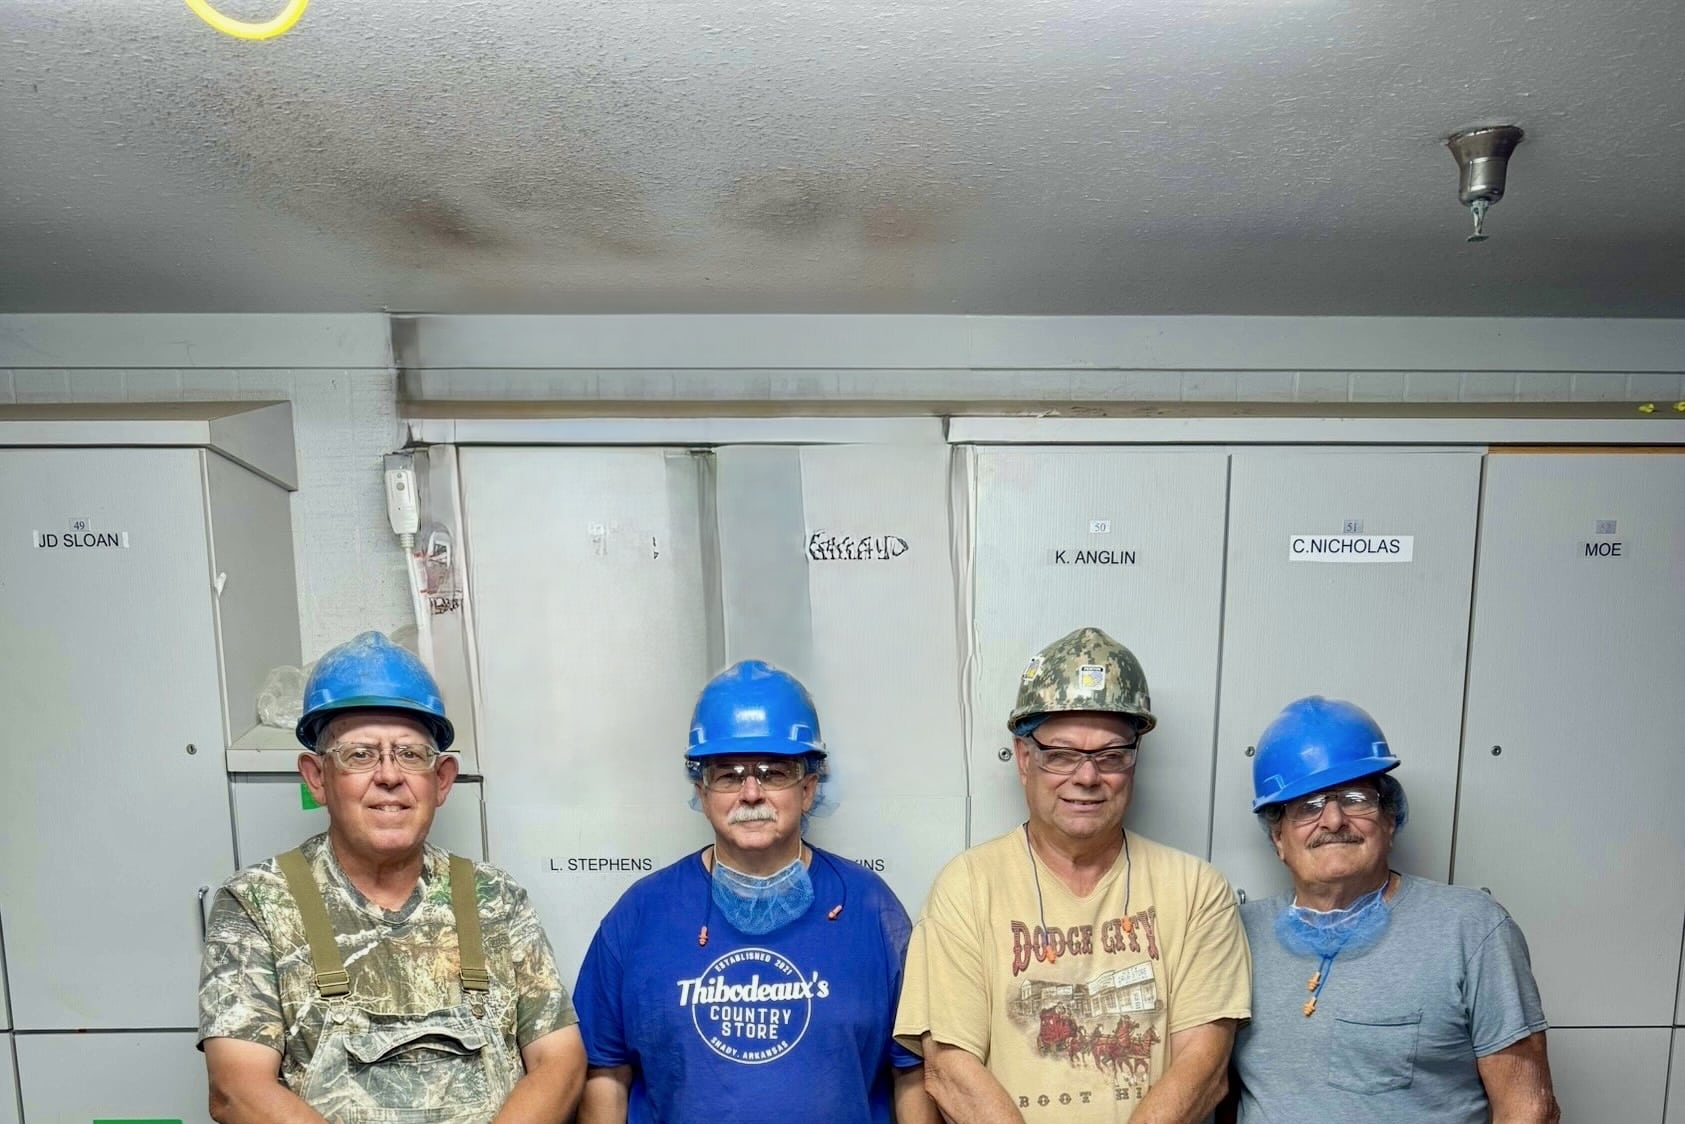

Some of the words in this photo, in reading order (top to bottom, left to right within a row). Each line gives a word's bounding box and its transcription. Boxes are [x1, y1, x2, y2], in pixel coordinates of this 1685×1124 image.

[73, 520, 85, 531] 49
[1094, 522, 1106, 532] 50
[38, 533, 58, 548] JD
[63, 533, 119, 548] SLOAN
[1292, 538, 1400, 554] C.NICHOLAS
[1585, 542, 1622, 556] MOE
[1055, 550, 1070, 565] K.
[1074, 550, 1136, 565] ANGLIN
[550, 858, 563, 871] L.
[567, 858, 653, 871] STEPHENS
[1011, 919, 1093, 977] DODGE
[1101, 905, 1160, 961] CITY
[714, 952, 771, 973] ESTABLISHED
[676, 970, 830, 1007] Thibodeaux's
[710, 1006, 792, 1025] COUNTRY
[721, 1021, 779, 1040] STORE
[742, 1040, 789, 1060] ARKANSAS
[1018, 1090, 1092, 1108] BOOT
